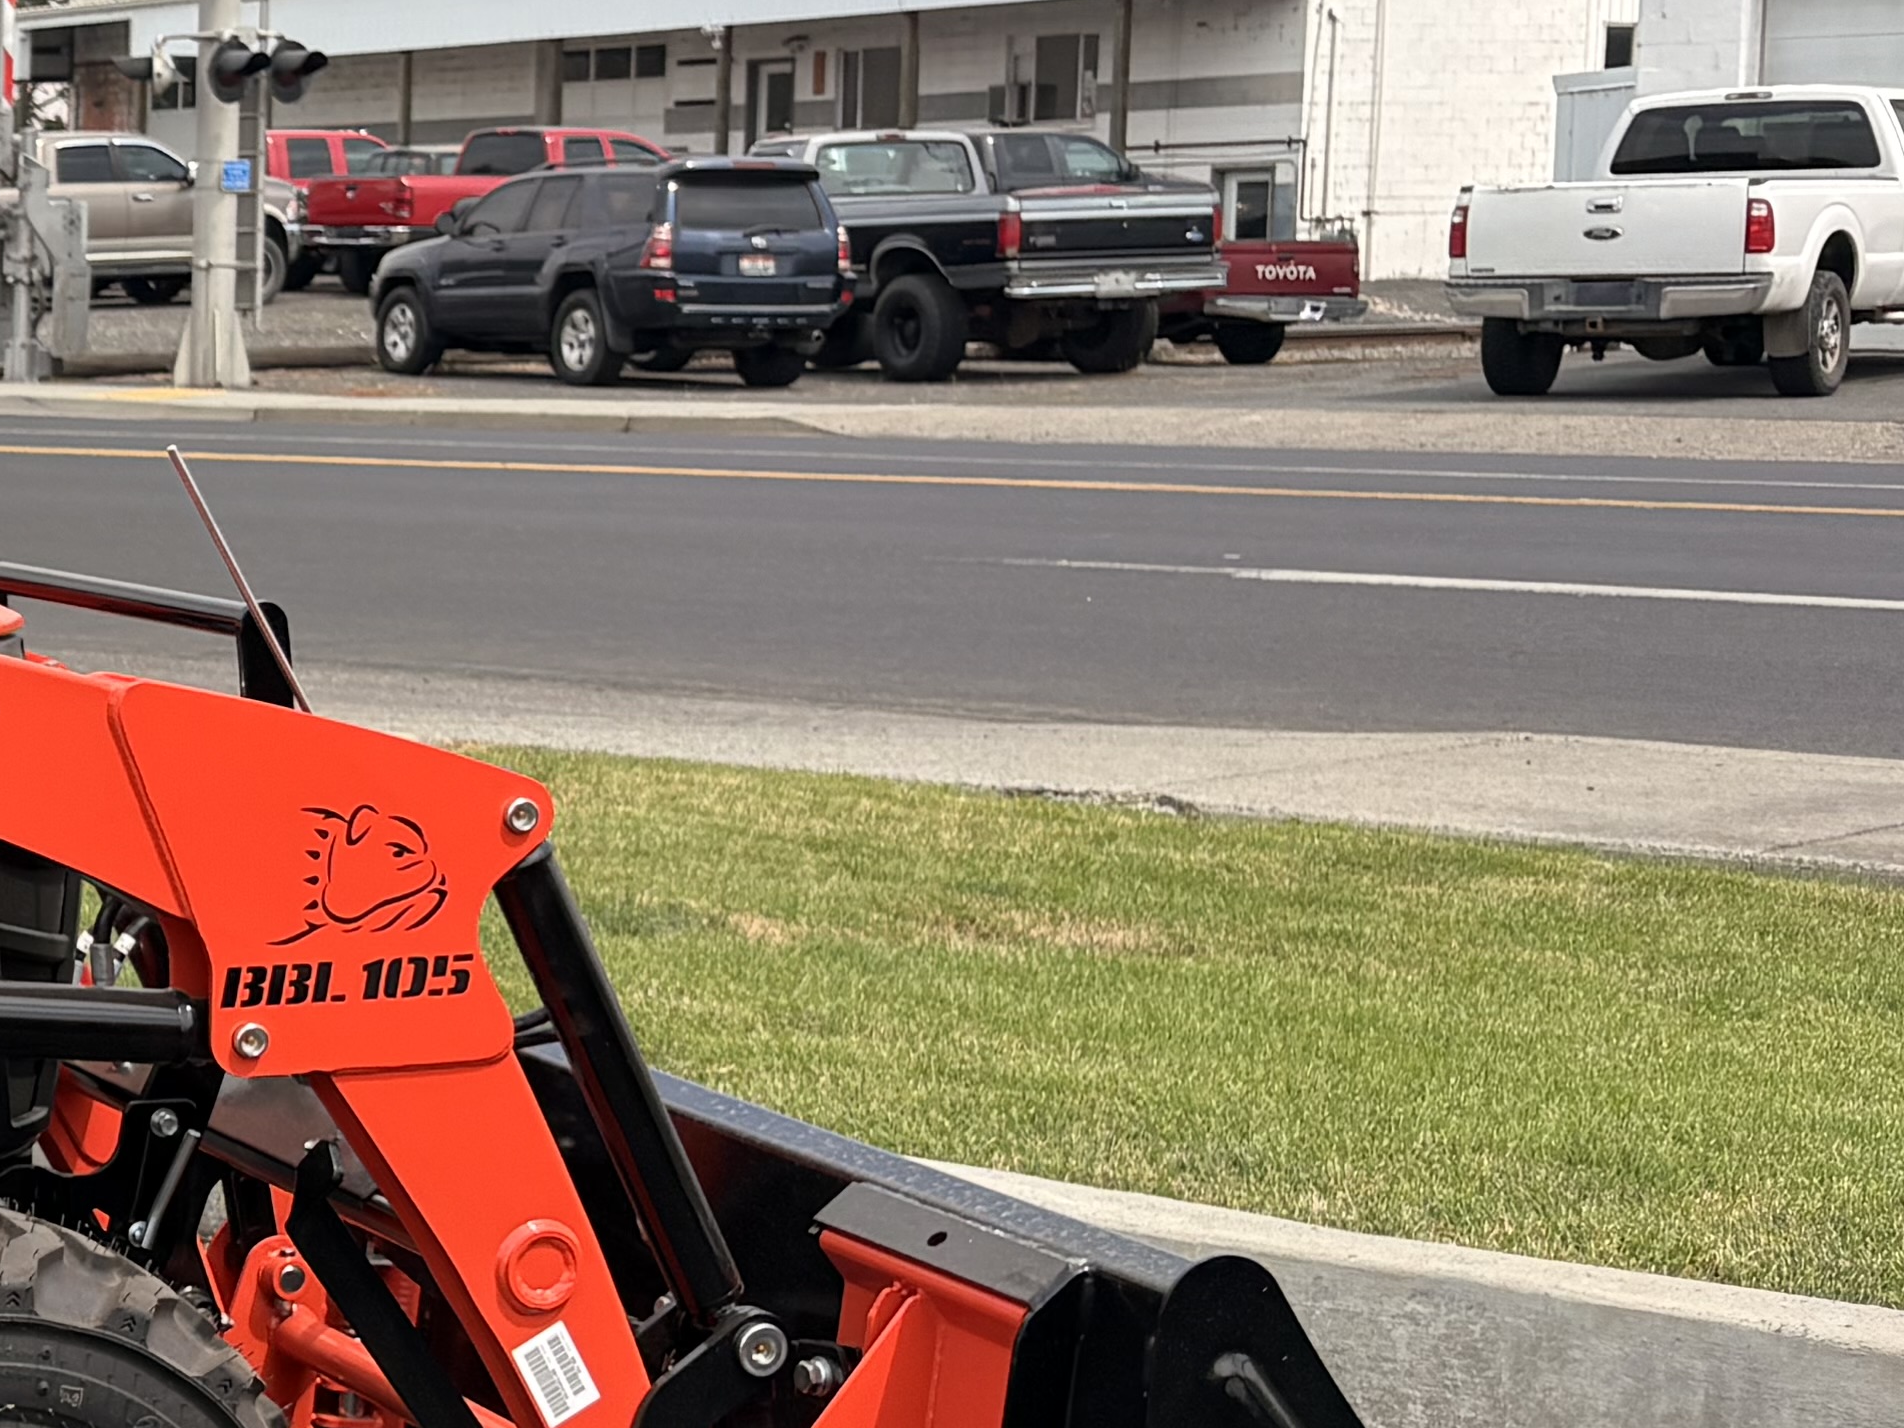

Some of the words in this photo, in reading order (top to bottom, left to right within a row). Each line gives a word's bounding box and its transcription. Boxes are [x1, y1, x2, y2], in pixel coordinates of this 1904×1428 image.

[1255, 264, 1316, 281] TOYOTA
[220, 962, 346, 1009] BBL
[362, 953, 474, 1000] 105
